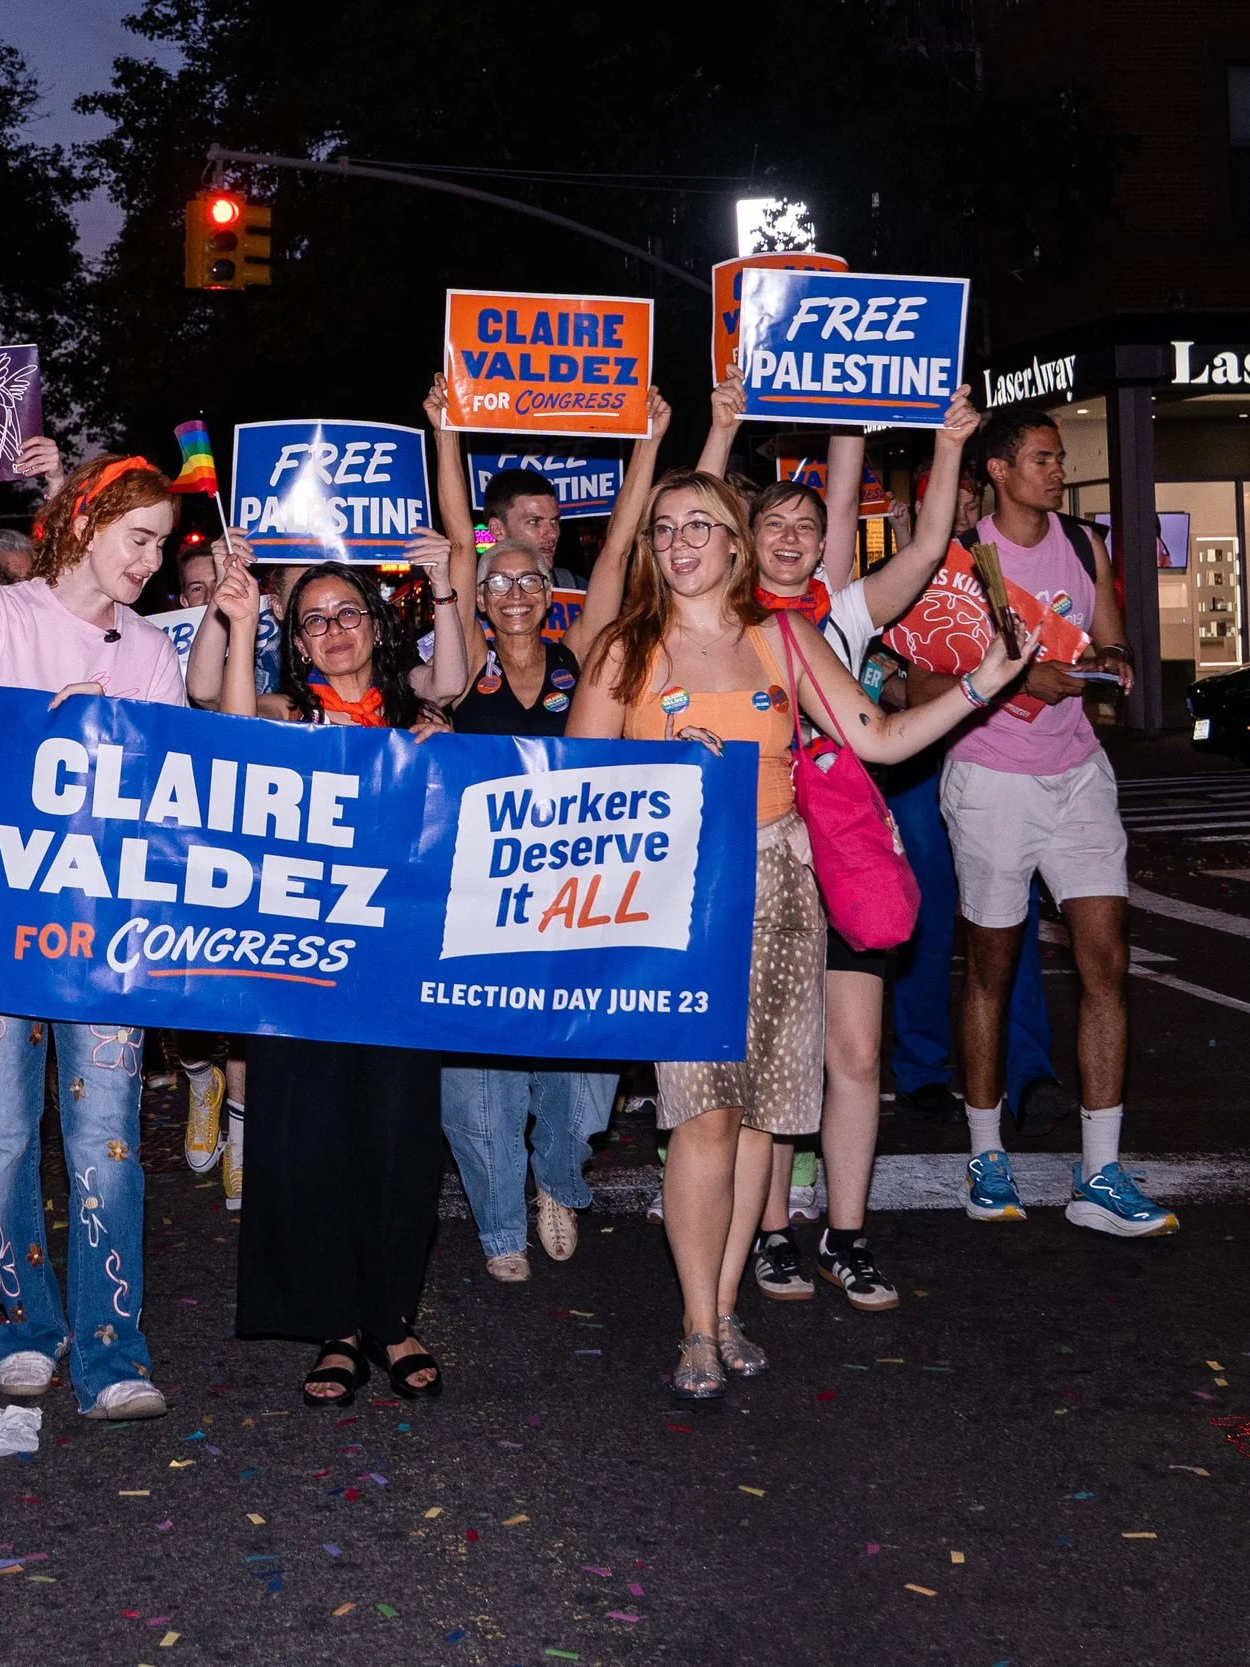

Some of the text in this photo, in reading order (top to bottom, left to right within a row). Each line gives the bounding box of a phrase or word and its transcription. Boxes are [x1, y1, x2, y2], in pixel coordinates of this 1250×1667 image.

[478, 308, 623, 348] CLAIRE
[786, 297, 927, 341] FREE
[461, 350, 638, 386] VALDEZ
[751, 350, 950, 396] PALESTINE
[983, 354, 1076, 408] LaserAway
[1171, 341, 1250, 384] La
[473, 390, 626, 415] FOR CONGRESS
[269, 442, 397, 487] FREE
[478, 470, 615, 502] PTINE
[31, 737, 360, 849] CLAIRE
[486, 781, 671, 833] Workers
[489, 830, 669, 879] Deserve
[495, 870, 649, 933] It ALL
[14, 917, 356, 974] FOR CONGRESS
[420, 981, 709, 1014] ELECTION DAY JUNE 23
